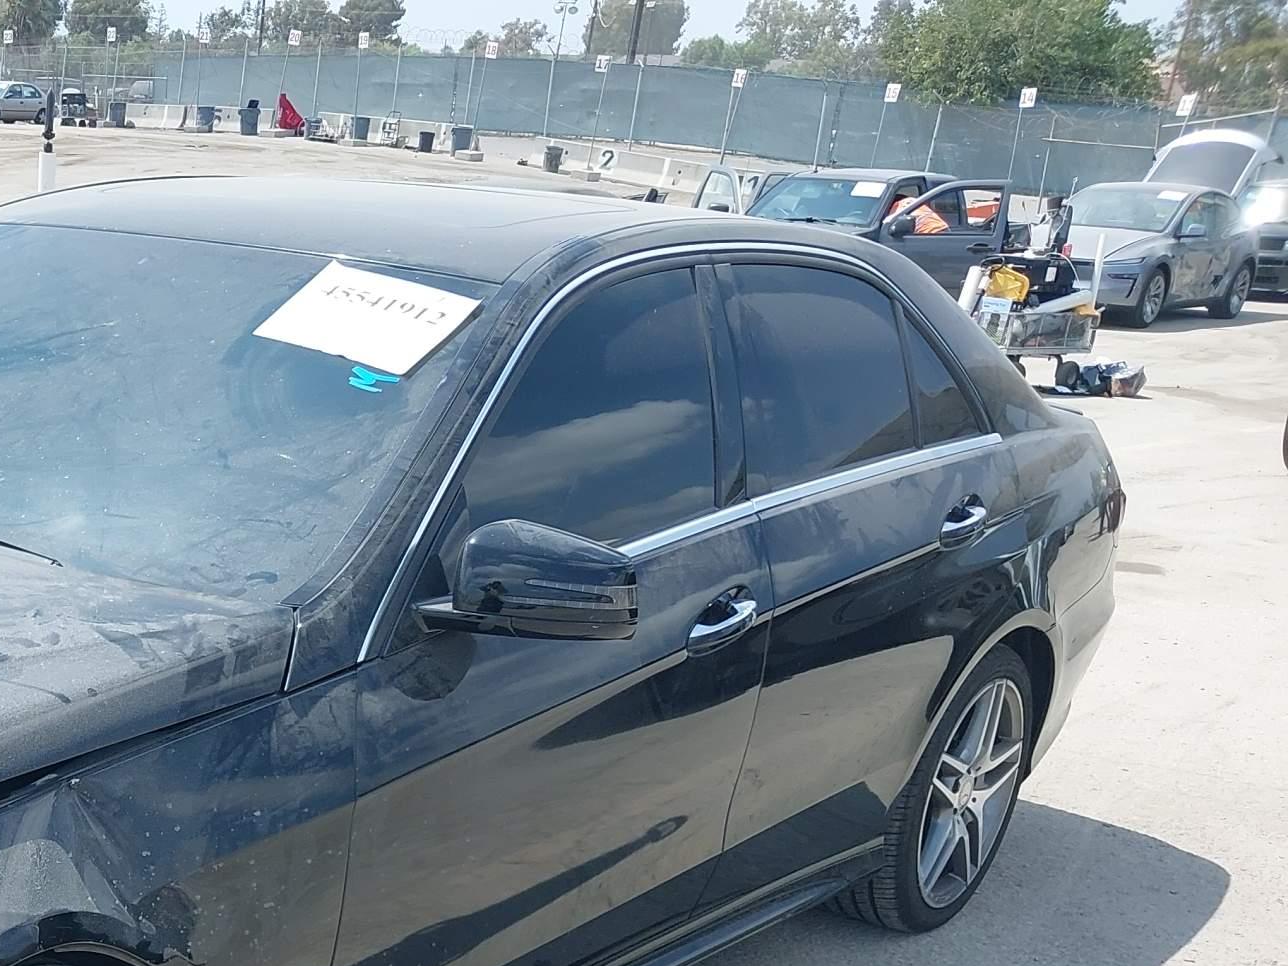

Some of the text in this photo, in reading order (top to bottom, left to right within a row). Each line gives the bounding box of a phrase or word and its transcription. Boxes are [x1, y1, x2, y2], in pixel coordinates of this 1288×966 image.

[4, 32, 13, 41] 23
[200, 31, 209, 41] 21
[289, 32, 300, 43] 20
[359, 35, 368, 45] 19
[487, 45, 497, 55] 18
[596, 58, 610, 69] 17
[886, 87, 899, 98] 15
[1021, 91, 1034, 104] 14
[599, 149, 615, 170] 2
[321, 284, 447, 326] 45541912
